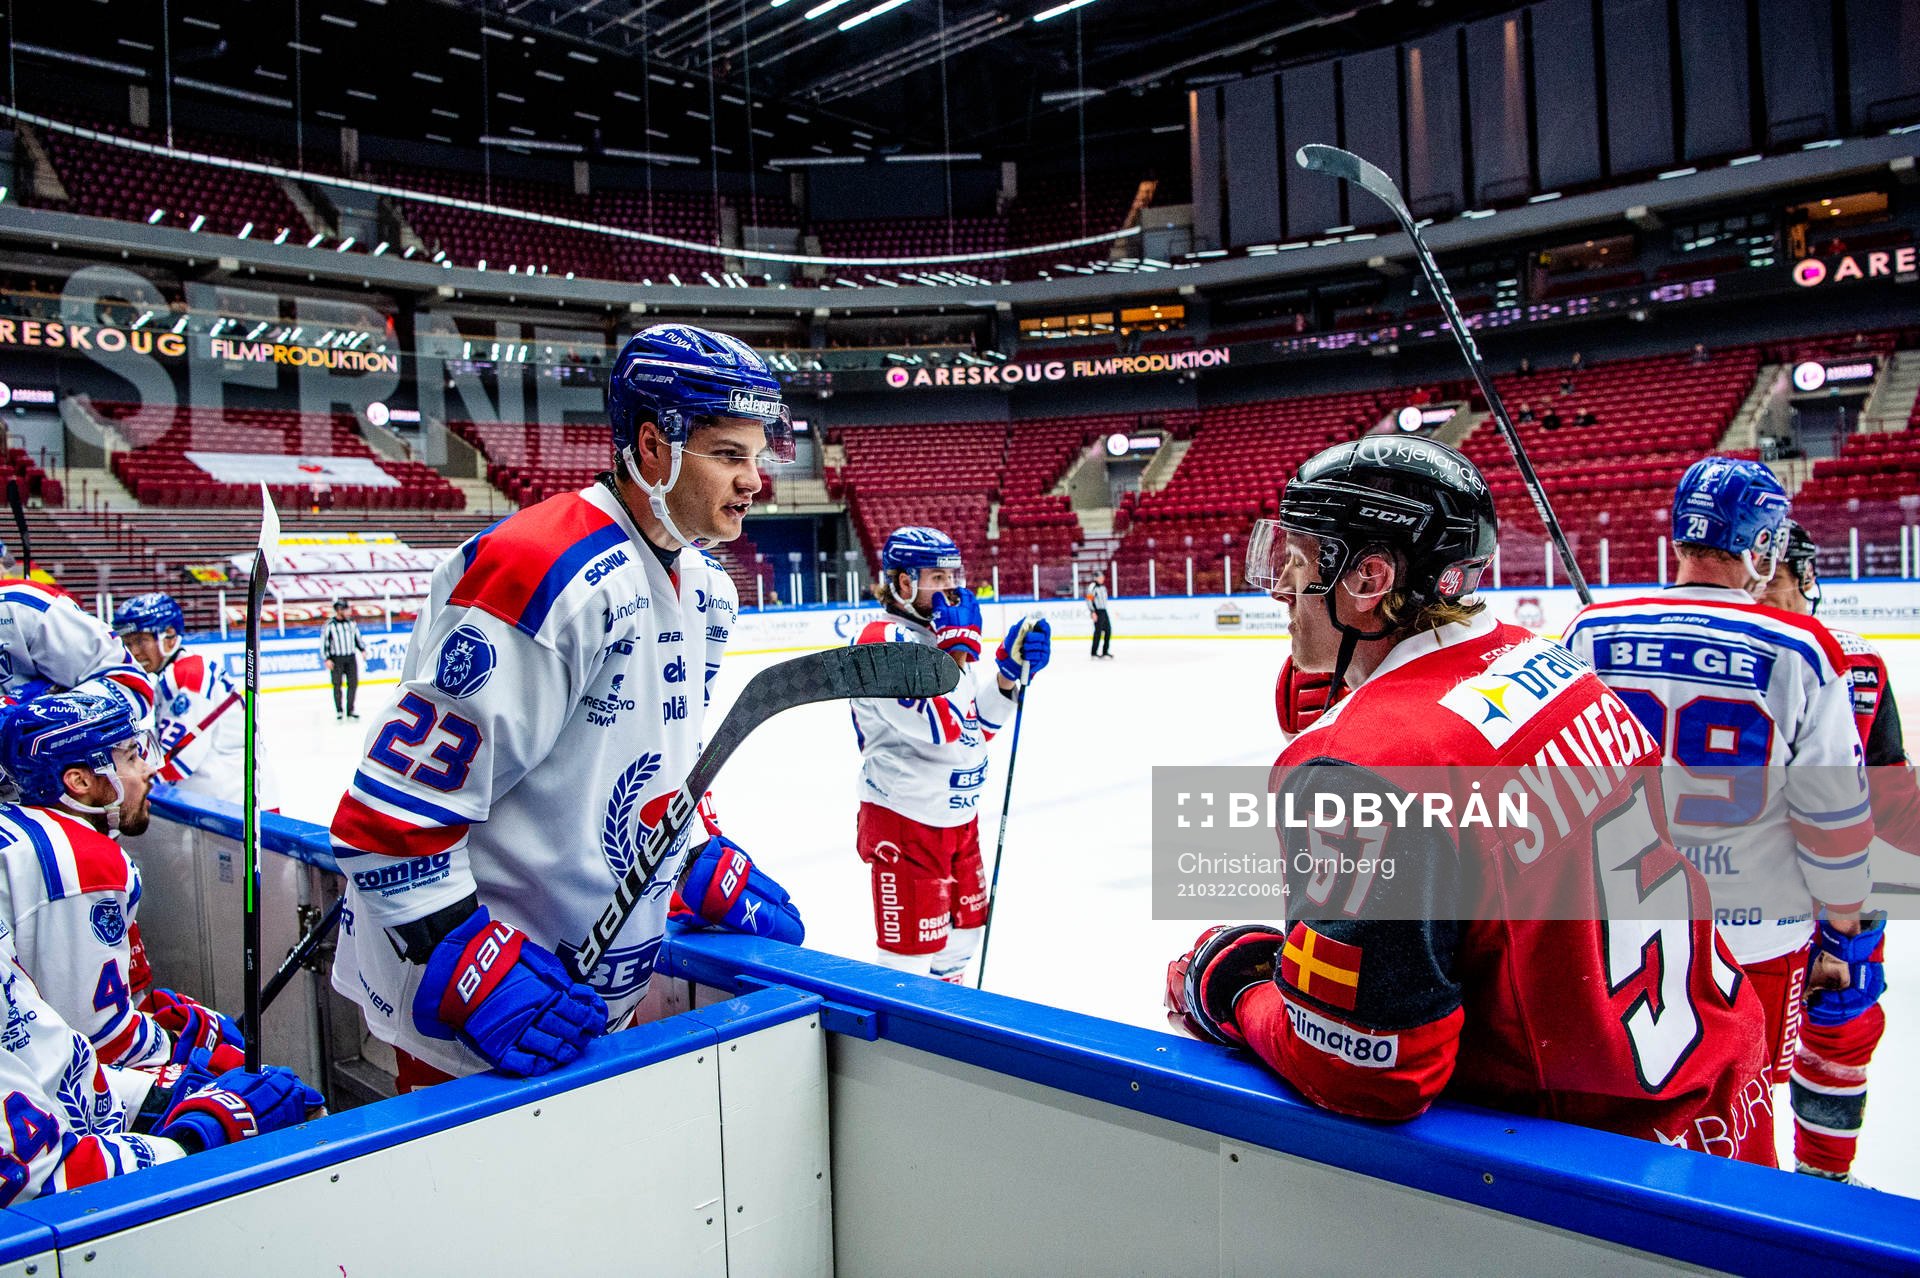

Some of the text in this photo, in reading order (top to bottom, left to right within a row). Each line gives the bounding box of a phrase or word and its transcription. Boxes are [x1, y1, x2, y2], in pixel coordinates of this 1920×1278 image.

[59, 264, 612, 462] SERNE
[210, 338, 398, 373] FILMPRODUKTION
[913, 347, 1231, 387] ARESKOUG FILMPRODUKTION
[1395, 443, 1488, 495] kjellander
[1359, 506, 1416, 526] CCM
[1686, 517, 1709, 539] 29
[584, 549, 630, 587] SCANIA
[368, 691, 483, 793] 23
[381, 884, 411, 898] Systems
[411, 875, 440, 889] Sweden
[880, 872, 904, 943] coolcon
[92, 958, 129, 1013] 4
